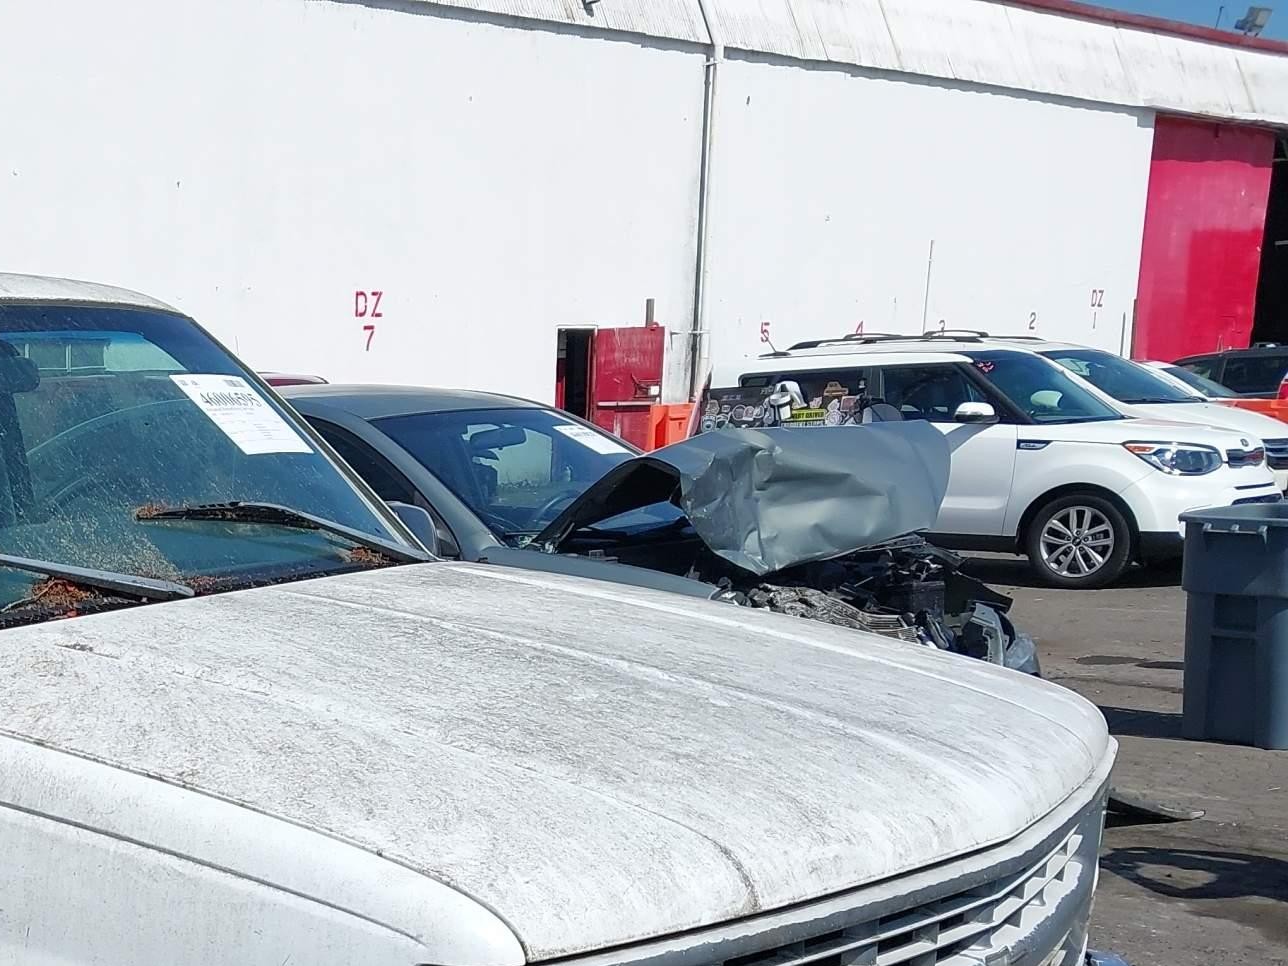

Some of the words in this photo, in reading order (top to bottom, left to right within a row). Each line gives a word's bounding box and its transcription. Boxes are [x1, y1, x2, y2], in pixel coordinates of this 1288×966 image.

[355, 291, 383, 318] DZ
[1091, 289, 1105, 308] DZ
[1028, 311, 1037, 330] 2
[363, 325, 375, 351] 7
[760, 321, 770, 343] 5
